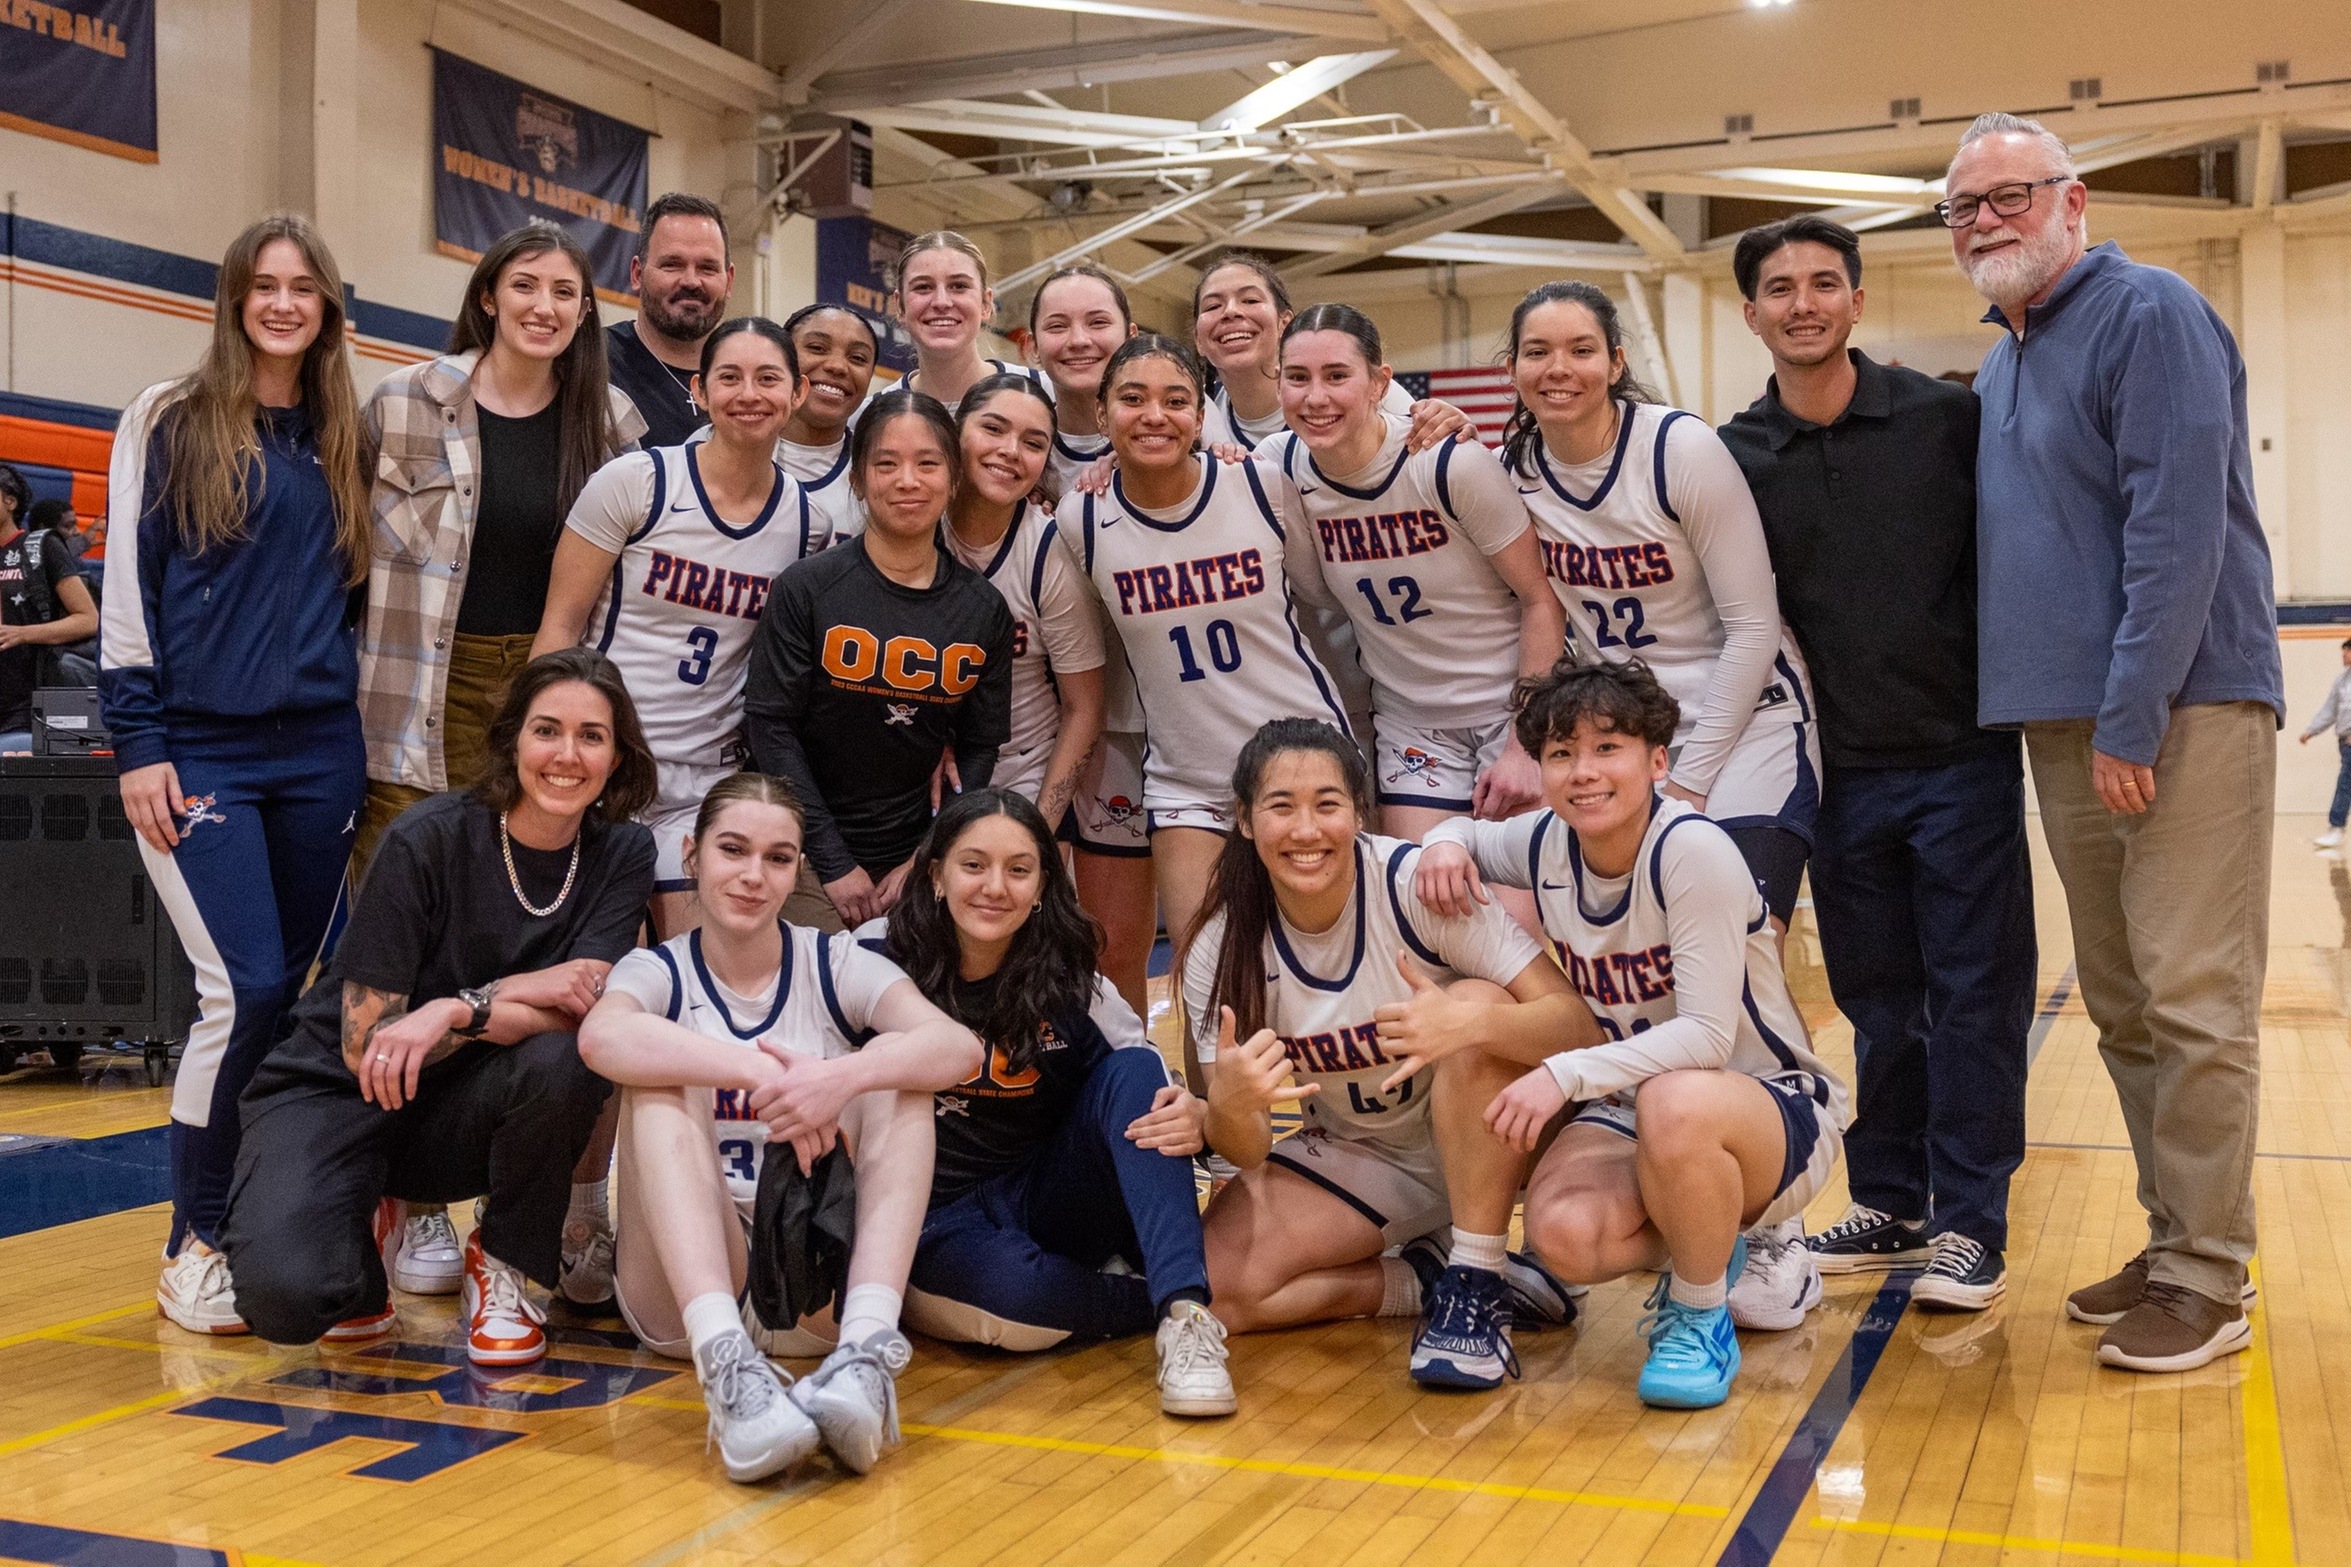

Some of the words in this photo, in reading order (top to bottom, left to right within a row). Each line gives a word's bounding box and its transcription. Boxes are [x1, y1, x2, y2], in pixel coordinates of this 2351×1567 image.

[443, 145, 530, 198] WOMEN'S
[534, 176, 640, 234] BASKETBALL
[1316, 509, 1450, 563] PIRATES
[642, 549, 775, 622] PIRATE
[1112, 547, 1265, 615] PIRATES
[1356, 575, 1434, 626] 12
[1168, 618, 1242, 683] 10
[1581, 596, 1659, 649] 22
[677, 626, 719, 686] 3
[821, 624, 987, 696] OCC
[1277, 1020, 1408, 1074] PIRAT
